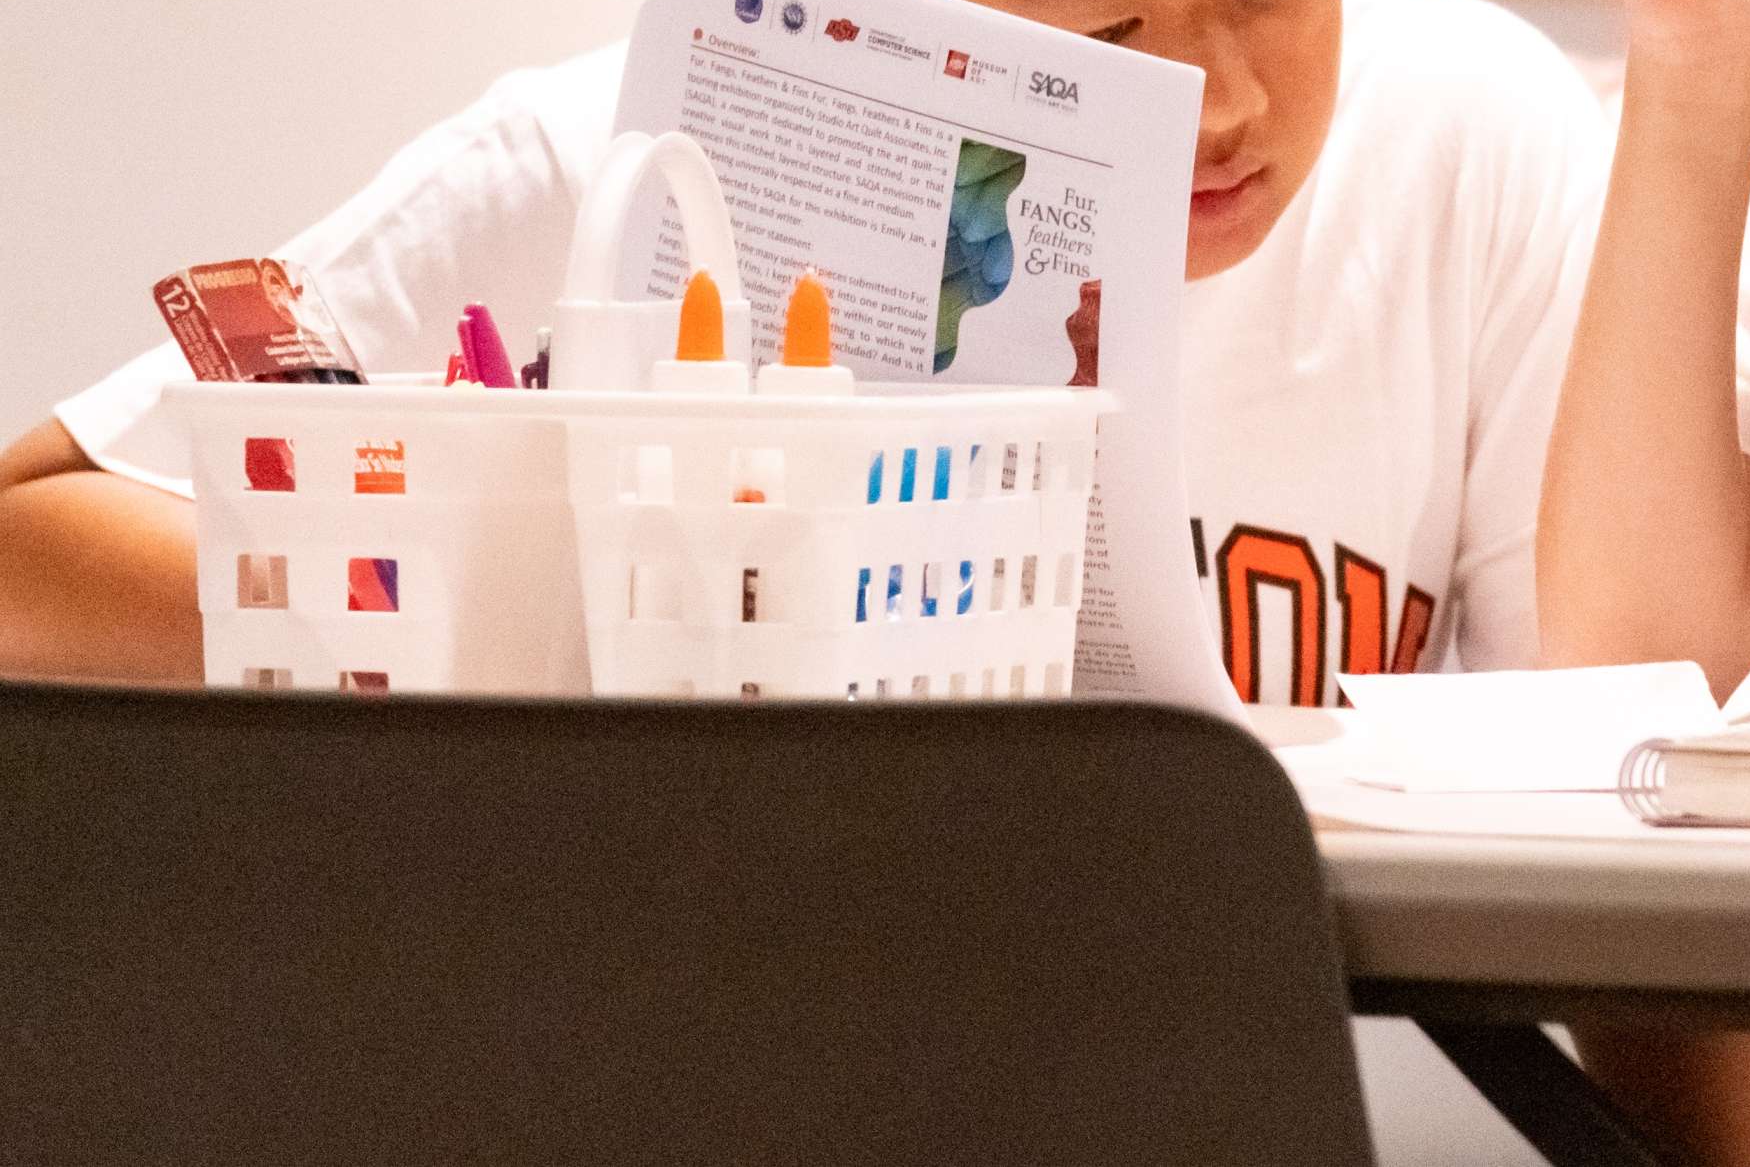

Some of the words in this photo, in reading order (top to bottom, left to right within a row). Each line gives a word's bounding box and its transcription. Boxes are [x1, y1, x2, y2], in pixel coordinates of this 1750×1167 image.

[867, 35, 903, 52] COMPUTER
[903, 43, 931, 61] SCIENCE
[972, 58, 1008, 75] MUSEUM
[687, 73, 718, 92] touring
[719, 84, 762, 101] exhibition
[763, 97, 804, 115] organized
[805, 108, 815, 120] by
[816, 111, 844, 128] Studio
[845, 120, 859, 132] Art
[741, 70, 777, 89] Feathers
[781, 81, 788, 93] &
[862, 107, 899, 127] Feathers
[903, 118, 911, 130] &
[1028, 70, 1080, 104] SAQA
[681, 107, 715, 124] creative
[720, 120, 745, 132] visual
[749, 129, 769, 140] work
[775, 135, 792, 147] that
[808, 145, 840, 162] layered
[845, 158, 862, 169] and
[910, 177, 920, 185] or
[925, 180, 945, 193] that
[728, 104, 769, 122] nonprofit
[771, 116, 812, 136] dedicated
[815, 129, 825, 140] to
[827, 135, 874, 156] promoting
[876, 148, 891, 160] the
[895, 155, 908, 165] art
[710, 150, 734, 168] being
[735, 161, 779, 180] universally
[780, 174, 823, 193] respected
[824, 187, 833, 196] as
[843, 190, 860, 204] fine
[862, 198, 875, 208] art
[725, 136, 740, 149] this
[776, 153, 810, 171] layered
[855, 176, 881, 191] SAQA
[882, 187, 925, 205] envisions
[926, 198, 942, 210] the
[718, 173, 748, 191] elected
[750, 183, 760, 195] by
[762, 187, 786, 202] SAQA
[788, 195, 802, 207] for
[804, 202, 820, 214] this
[823, 209, 867, 227] exhibition
[870, 223, 878, 231] is
[880, 223, 906, 239] Emily
[735, 199, 757, 212] artist
[758, 206, 775, 217] and
[1064, 187, 1098, 214] Fur,
[1020, 199, 1095, 237] FANGS,
[1024, 223, 1093, 256] feathers
[755, 249, 778, 264] many
[848, 277, 897, 296] submitted
[898, 289, 909, 300] to
[1024, 248, 1050, 275] &
[1052, 252, 1091, 278] Fins
[161, 284, 191, 319] 12
[837, 290, 856, 303] into
[859, 297, 878, 308] one
[880, 303, 929, 321] particular
[843, 311, 873, 325] within
[876, 320, 894, 330] our
[896, 325, 927, 340] newly
[859, 331, 870, 342] to
[876, 336, 905, 350] which
[909, 346, 924, 355] we
[880, 353, 901, 367] And
[904, 360, 913, 369] is
[916, 363, 925, 373] it
